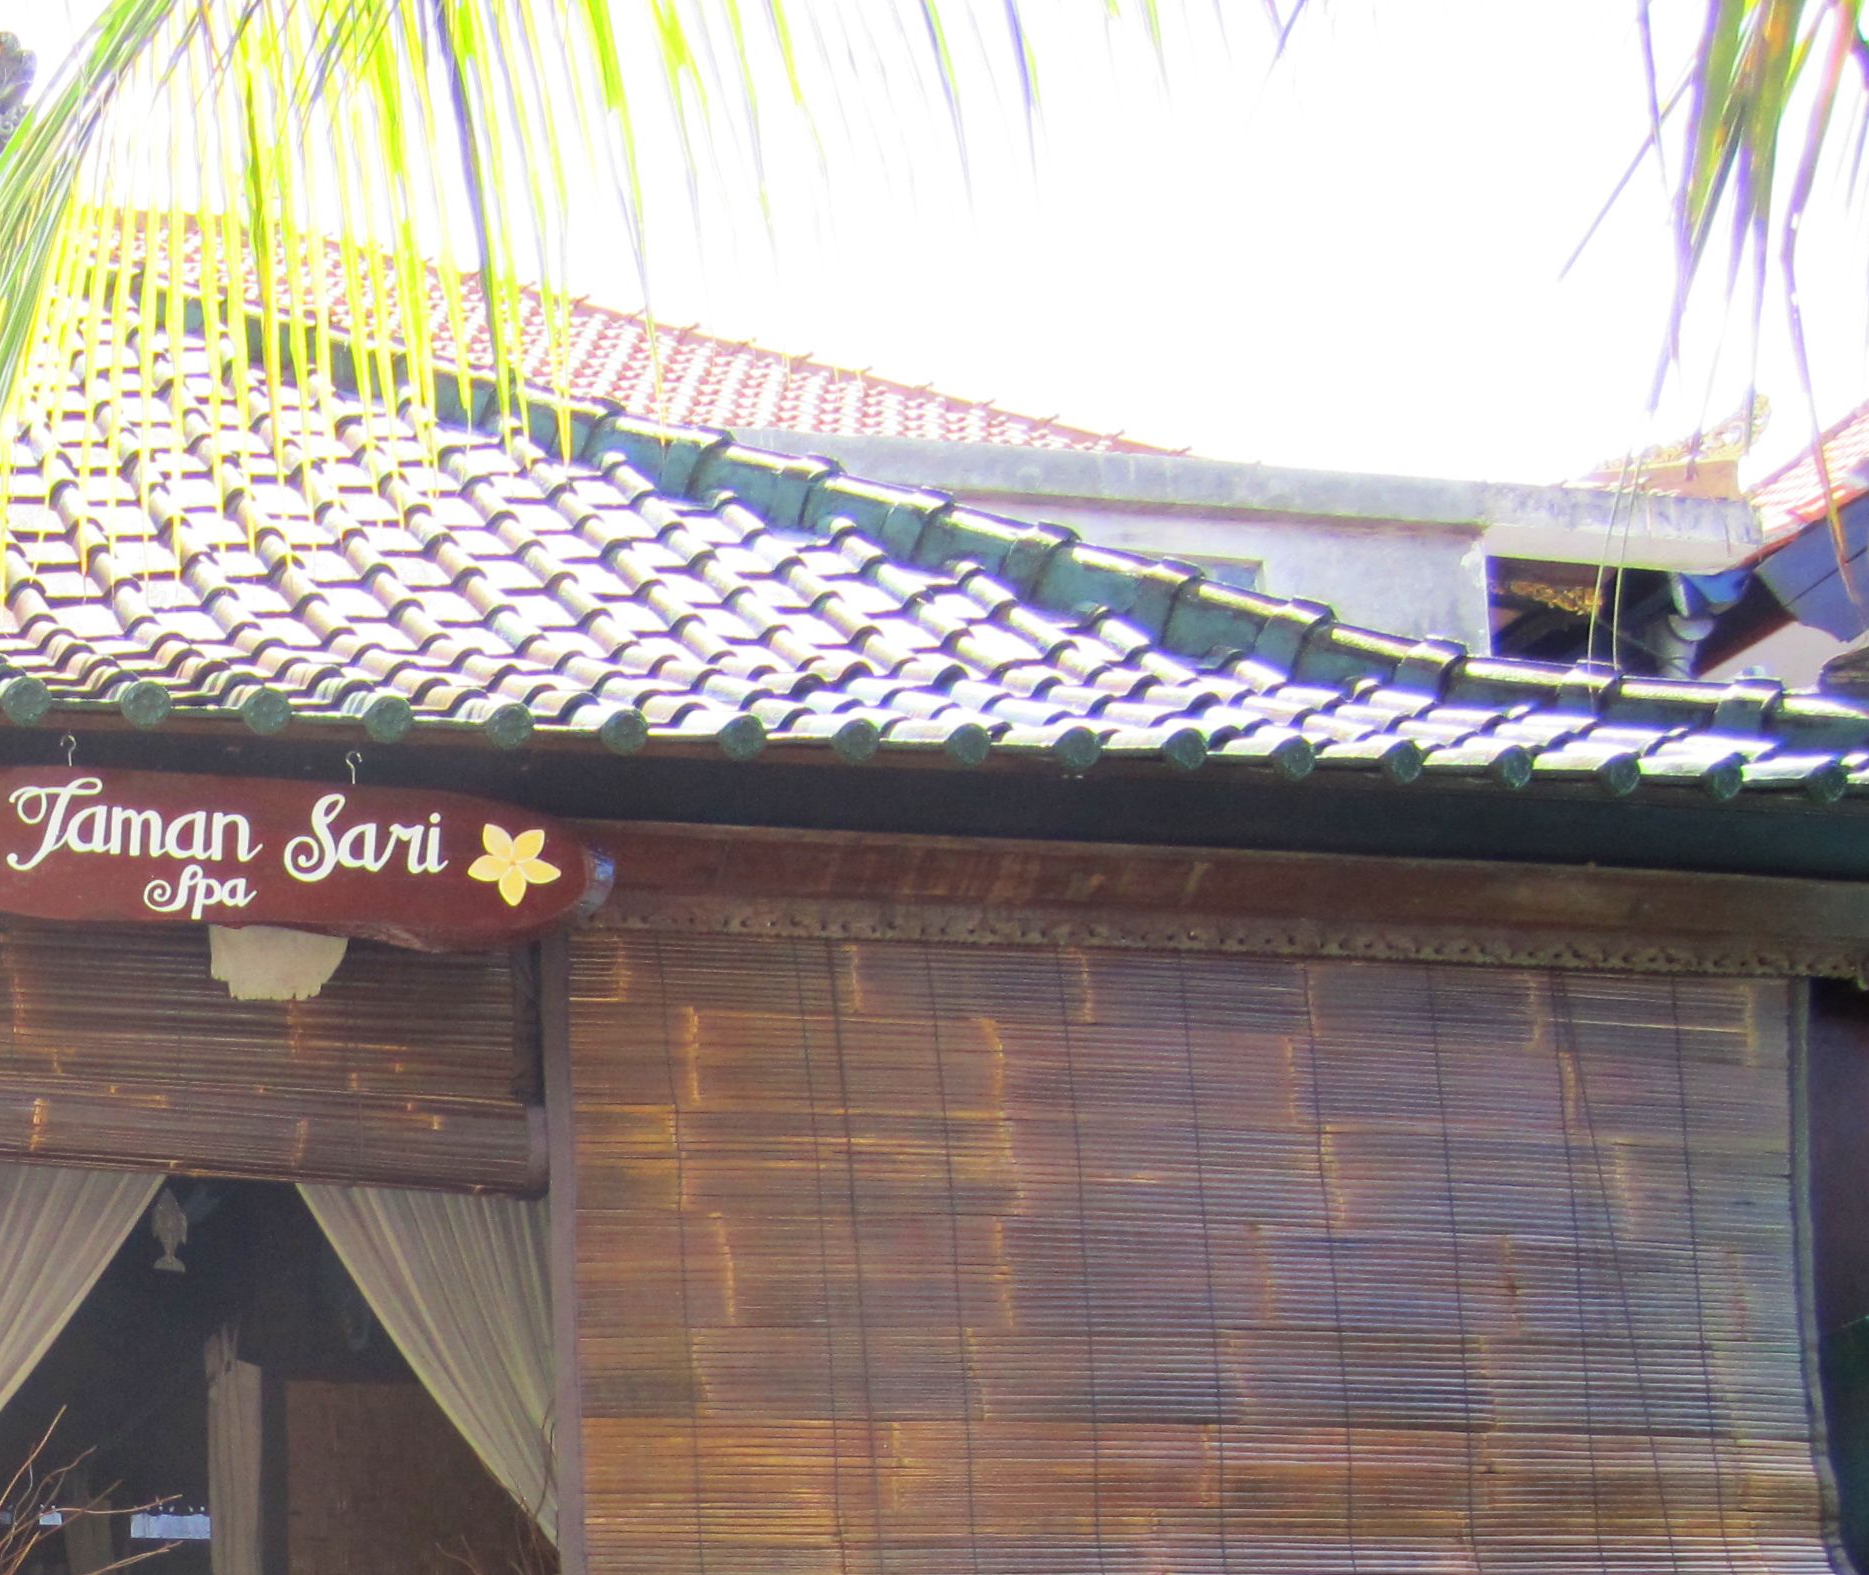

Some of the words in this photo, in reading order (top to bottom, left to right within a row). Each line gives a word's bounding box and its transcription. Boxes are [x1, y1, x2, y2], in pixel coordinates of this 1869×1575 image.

[7, 776, 264, 871] Taman
[283, 793, 449, 882] Sari
[142, 863, 258, 920] Spa
